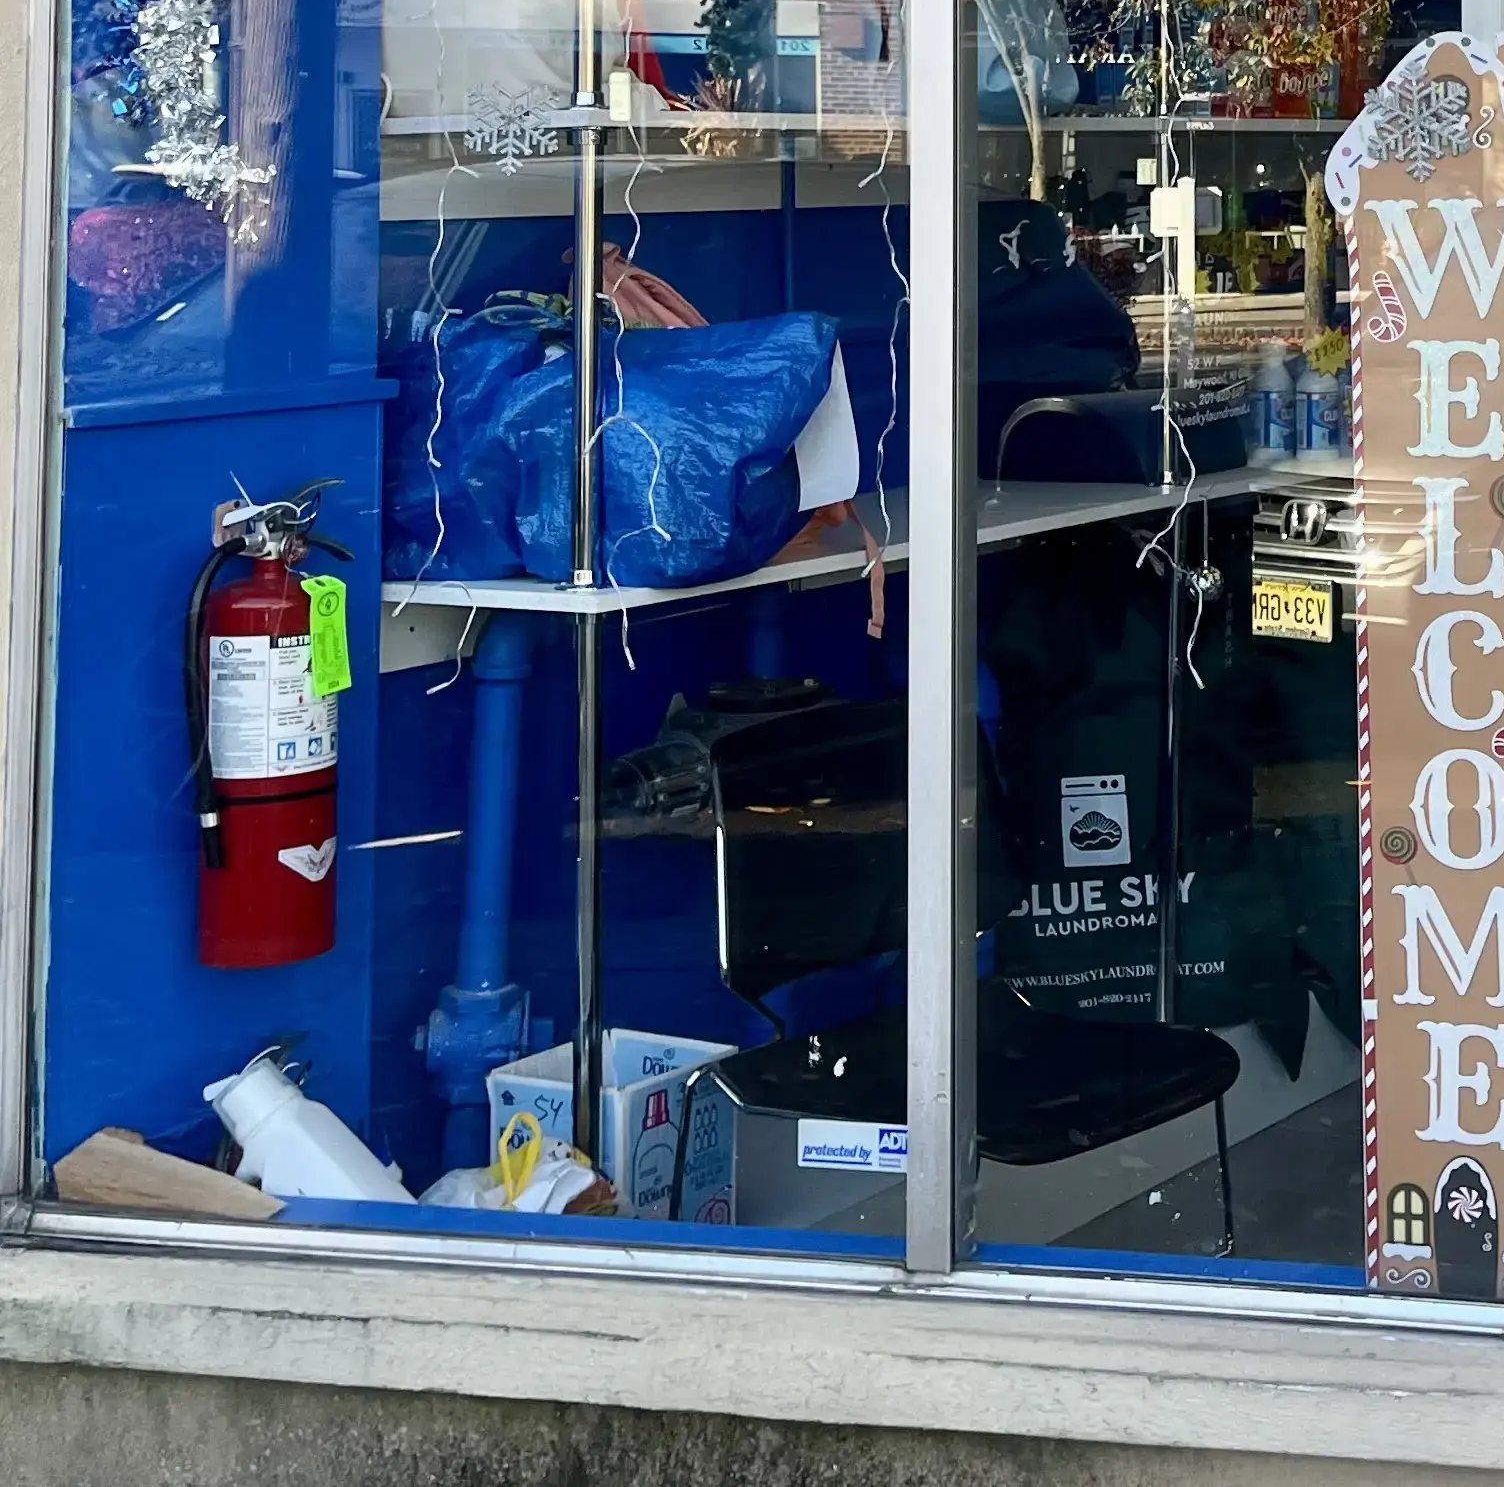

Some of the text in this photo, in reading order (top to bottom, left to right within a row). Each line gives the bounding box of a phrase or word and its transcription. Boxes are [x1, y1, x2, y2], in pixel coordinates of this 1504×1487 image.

[1035, 912, 1158, 938] LAUNDROMA
[533, 1094, 565, 1129] 54
[880, 1131, 908, 1151] ADT
[802, 1144, 873, 1162] protected by
